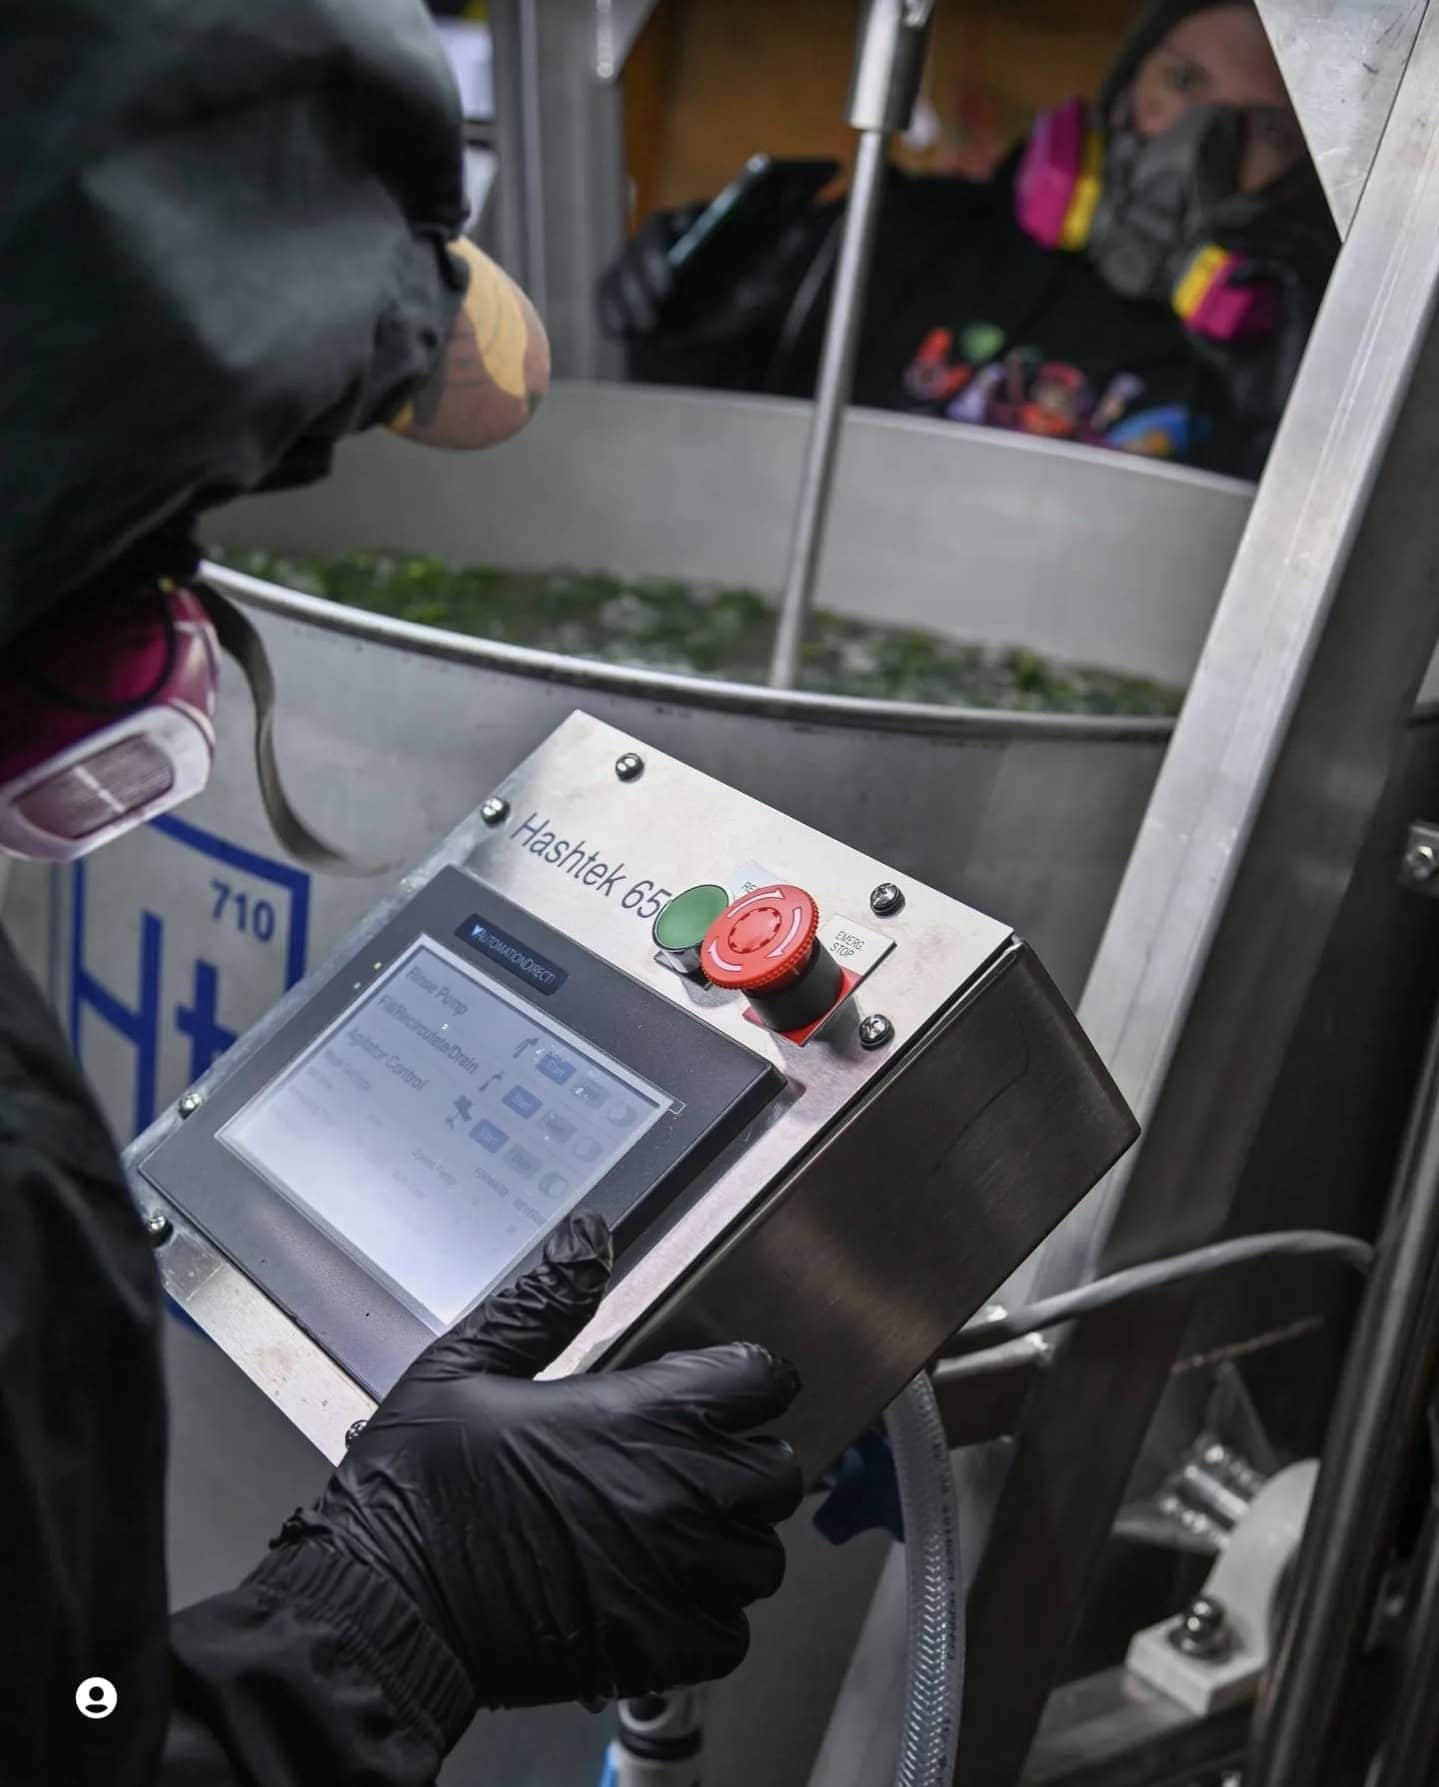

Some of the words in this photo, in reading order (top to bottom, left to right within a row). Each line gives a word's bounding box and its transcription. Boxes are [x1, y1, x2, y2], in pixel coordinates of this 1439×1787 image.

[510, 812, 627, 897] Hashtek
[210, 880, 276, 943] 710
[829, 942, 856, 958] STOP
[385, 1055, 431, 1091] Control
